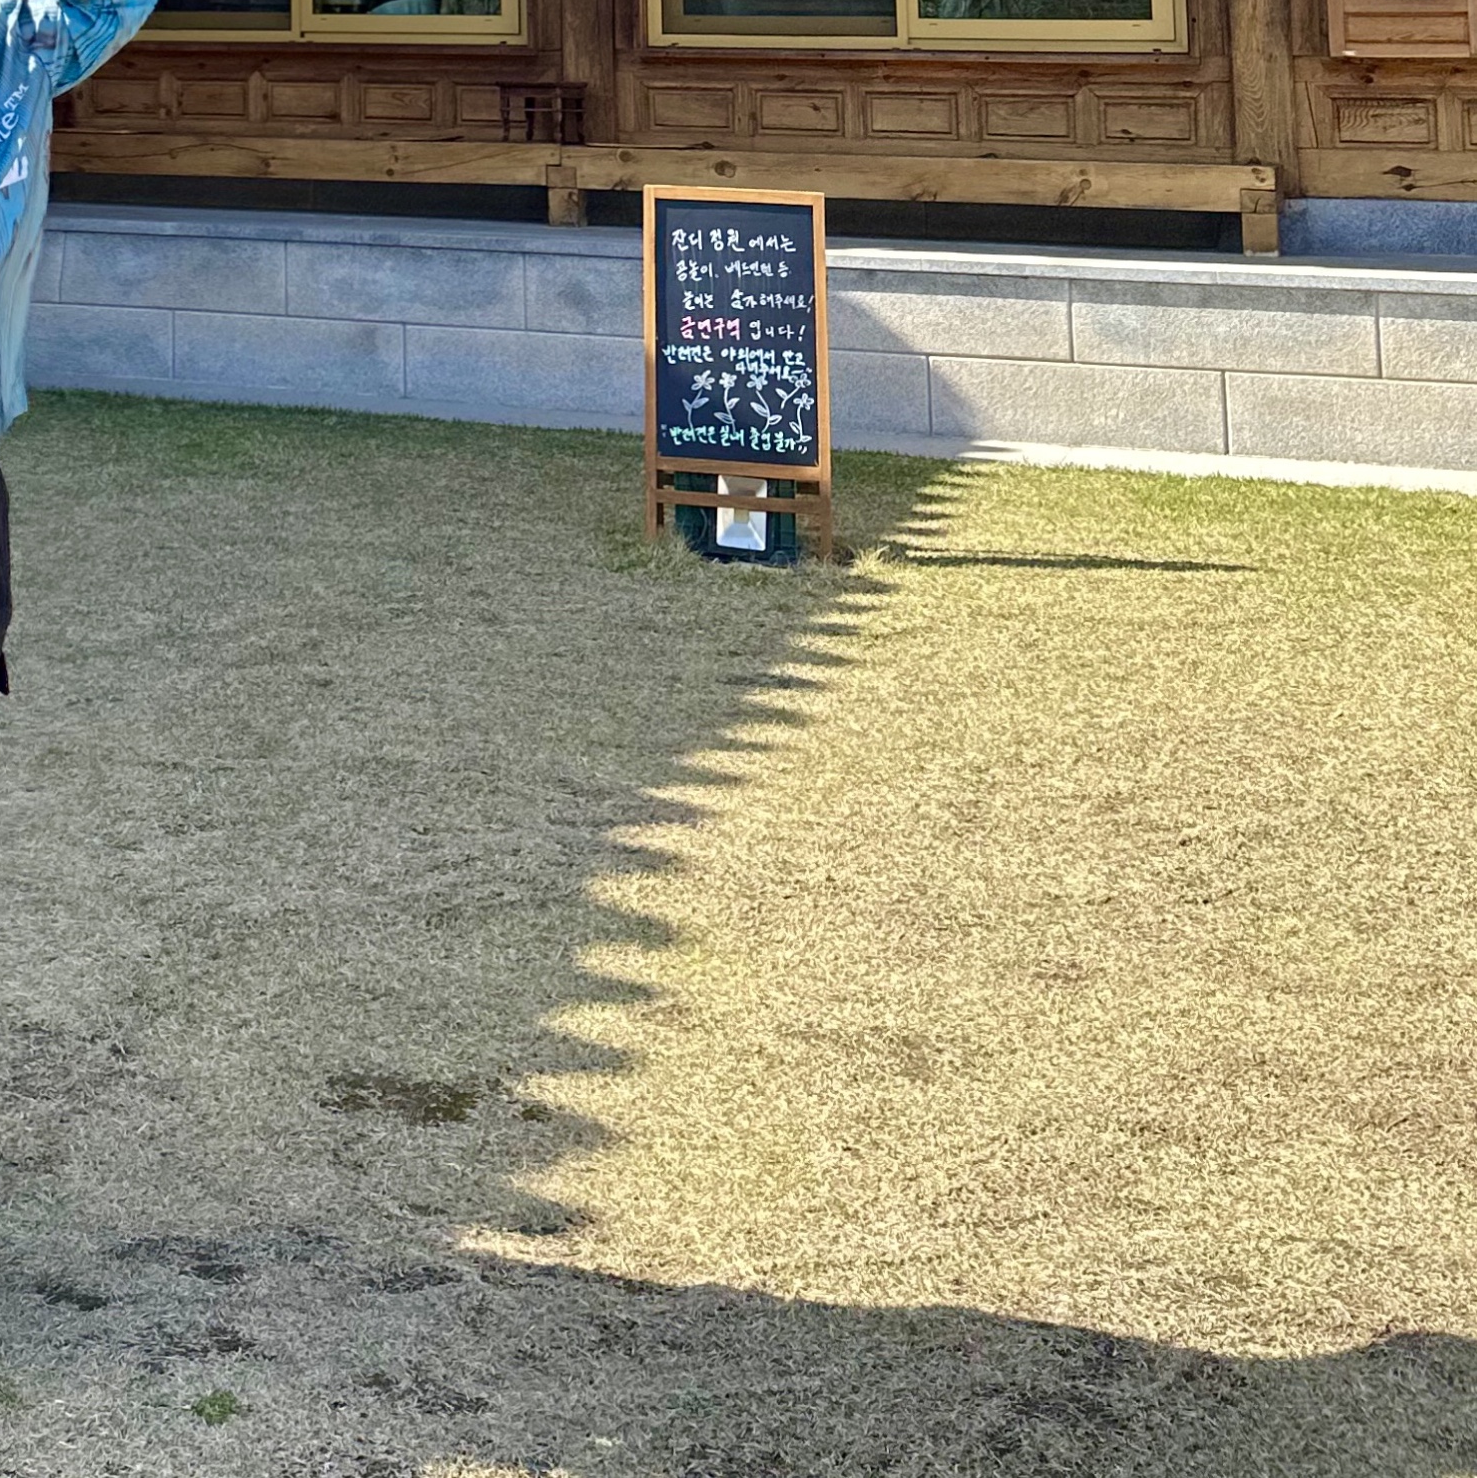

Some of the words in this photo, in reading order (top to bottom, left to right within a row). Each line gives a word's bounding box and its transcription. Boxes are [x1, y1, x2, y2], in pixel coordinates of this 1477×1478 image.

[672, 228, 702, 252] 잔디
[680, 316, 741, 340] 금연구역
[661, 344, 714, 365] 반려견은
[669, 425, 717, 446] 반려견은
[719, 425, 745, 447] 실내
[749, 427, 772, 451] 출입
